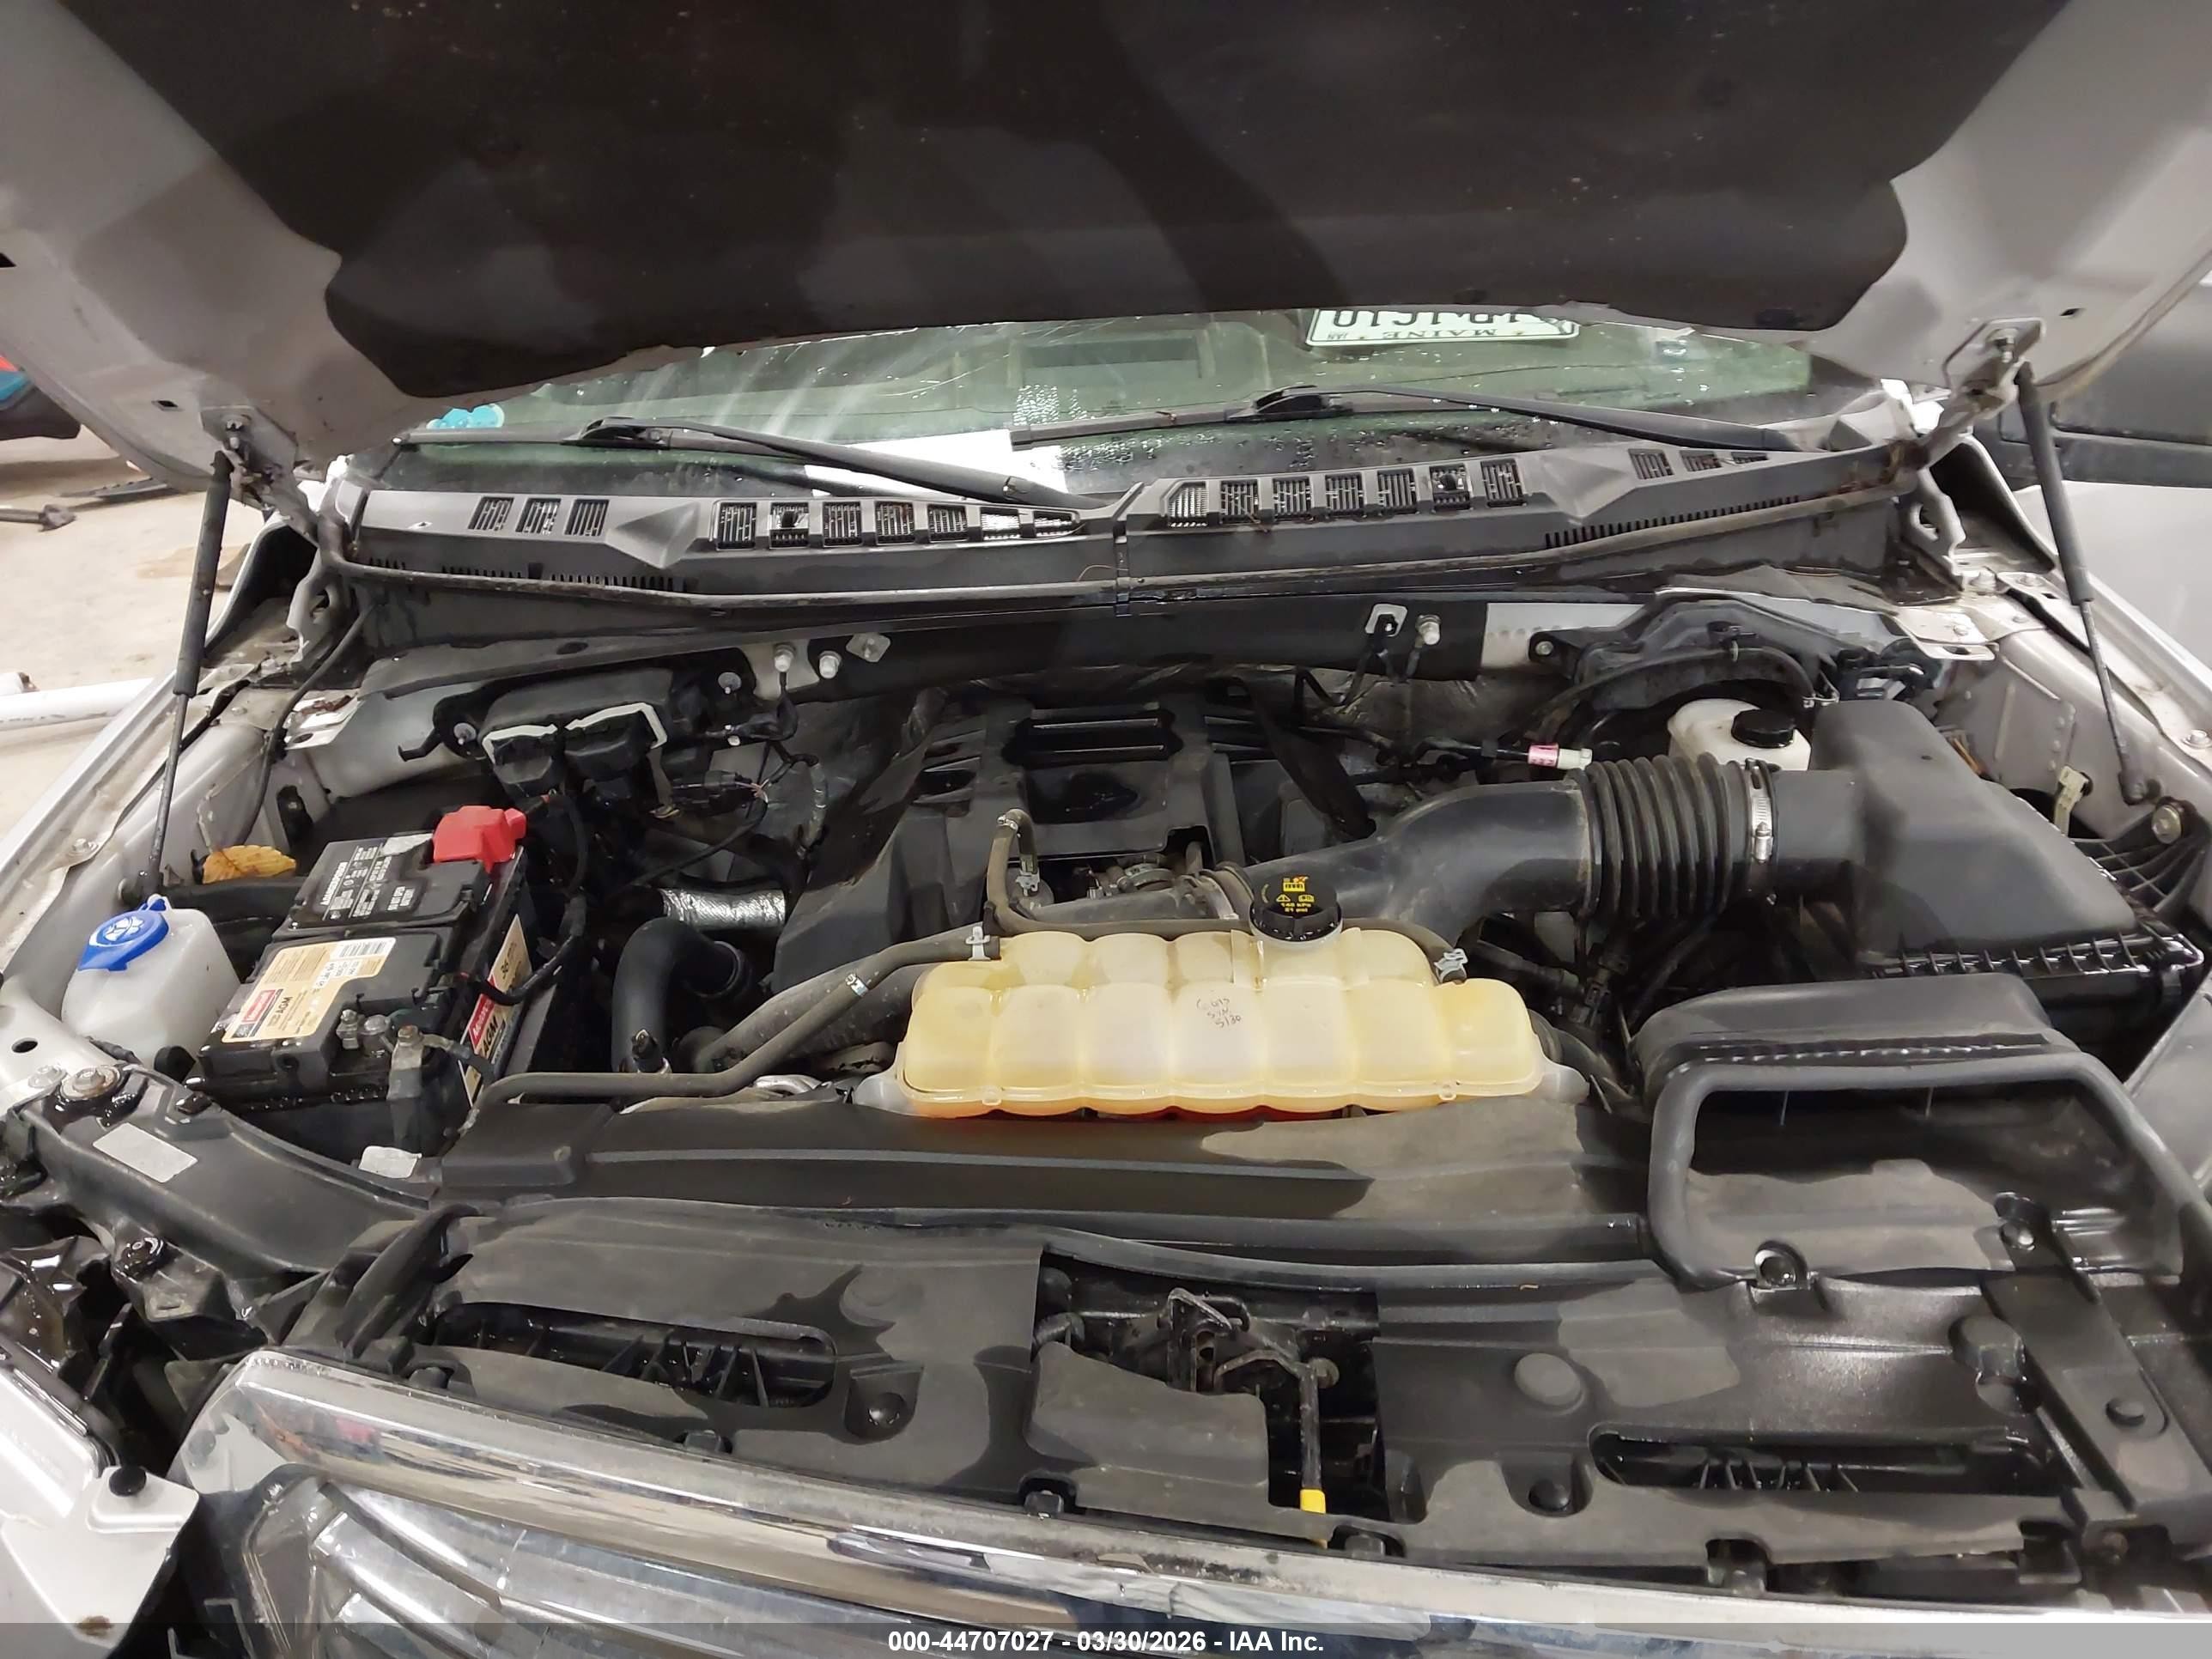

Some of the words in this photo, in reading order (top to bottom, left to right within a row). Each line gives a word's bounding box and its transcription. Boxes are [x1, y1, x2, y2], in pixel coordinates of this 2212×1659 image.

[1382, 329, 1498, 339] MAINE
[276, 996, 293, 1014] AGM
[482, 1015, 499, 1054] AGM
